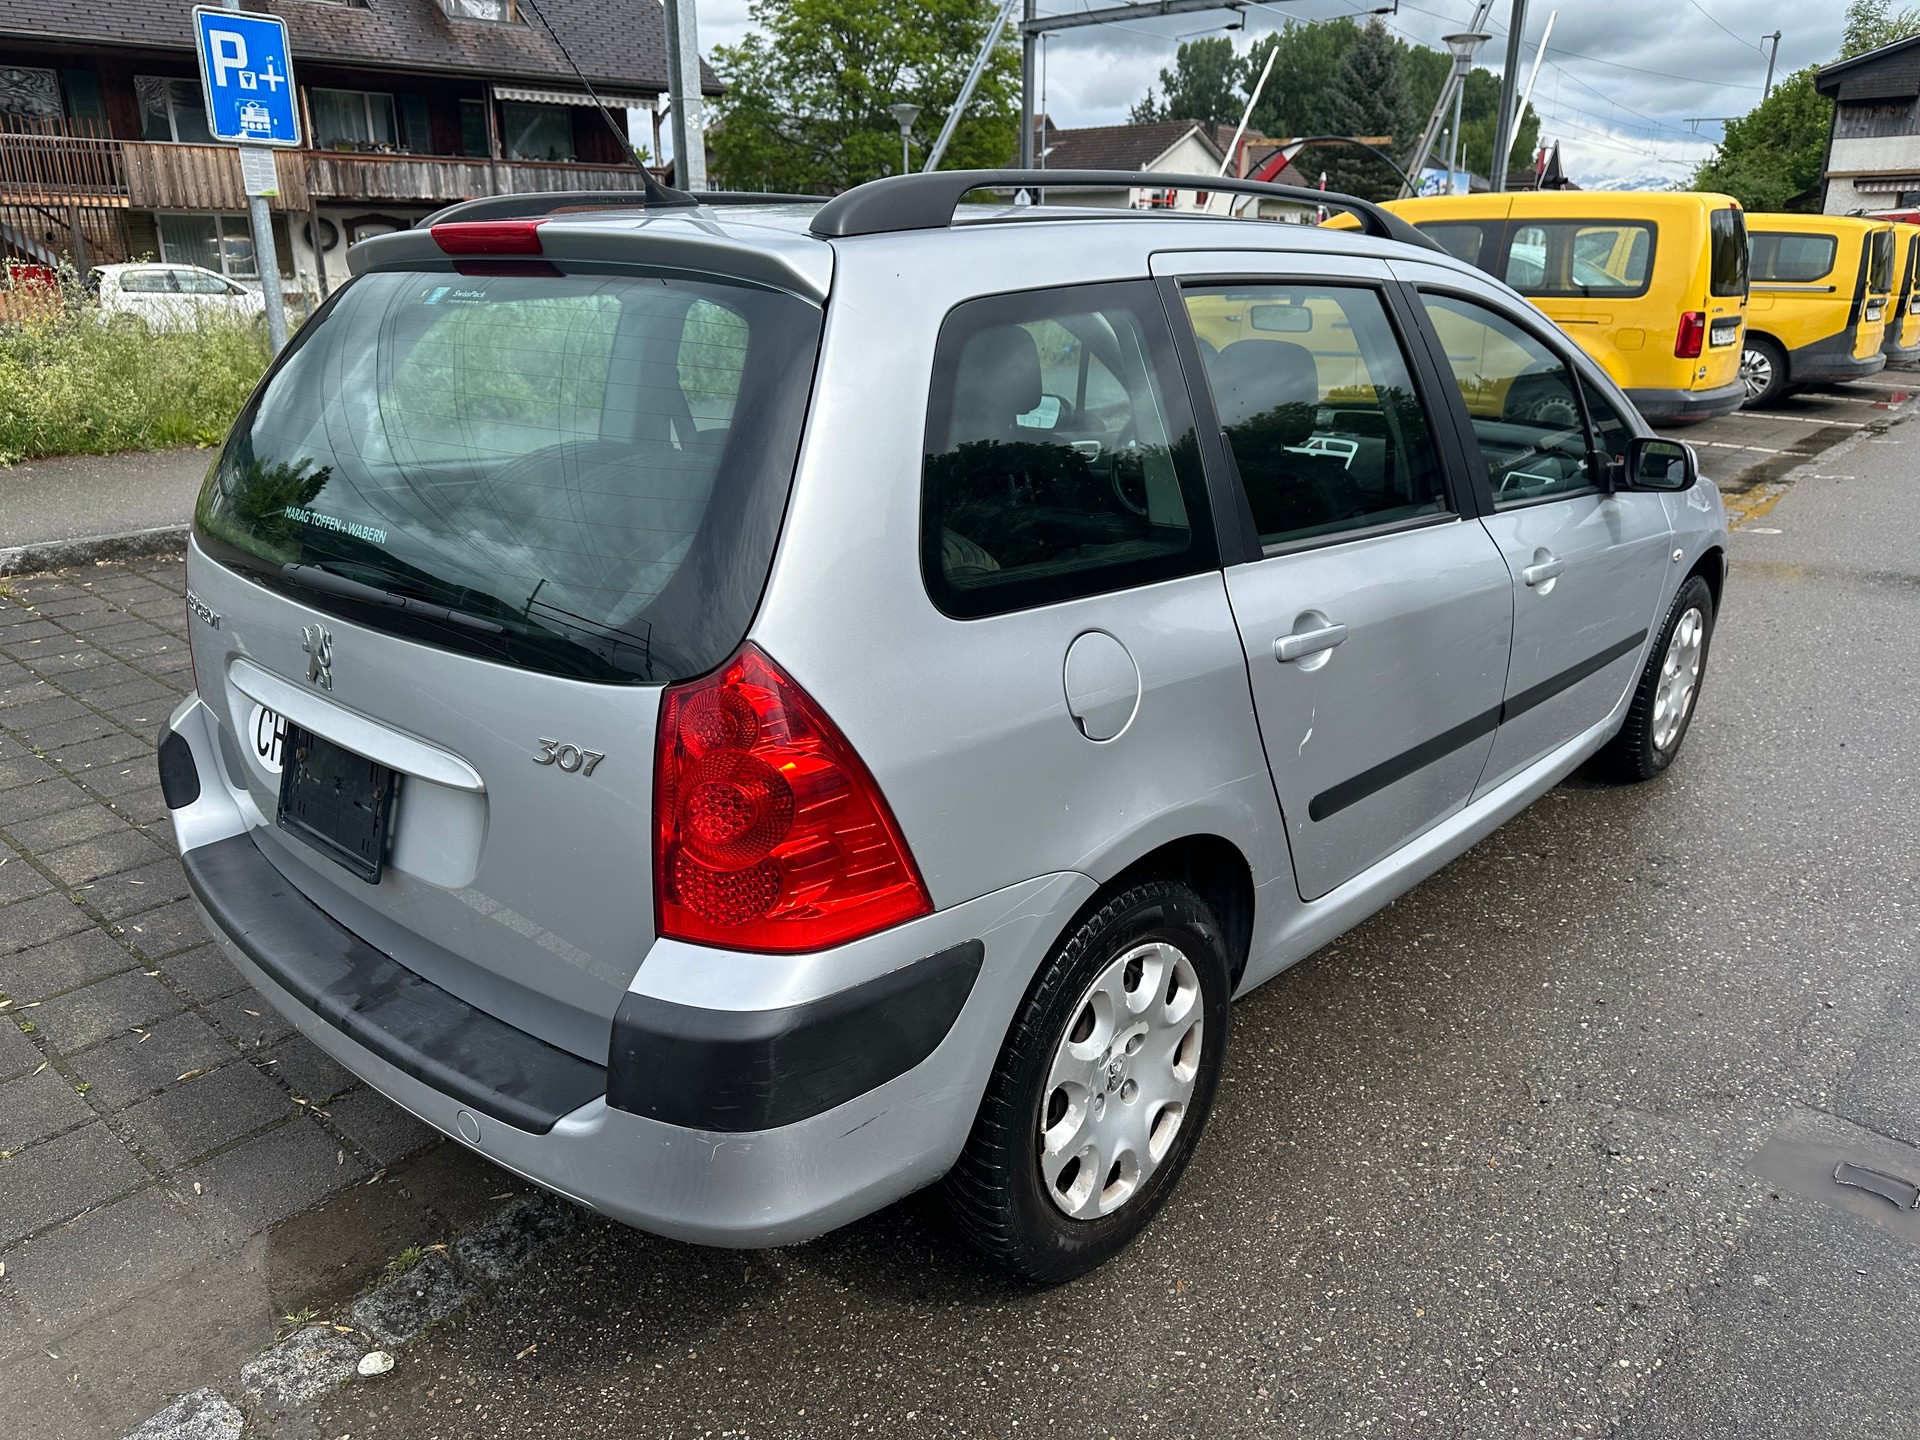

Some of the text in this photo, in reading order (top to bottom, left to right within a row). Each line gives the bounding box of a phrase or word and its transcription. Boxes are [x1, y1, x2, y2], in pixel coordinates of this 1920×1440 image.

[209, 30, 248, 87] P
[311, 512, 341, 532] TOFFEN
[348, 522, 387, 544] WABERN
[257, 707, 287, 766] CH
[532, 736, 605, 777] 307
